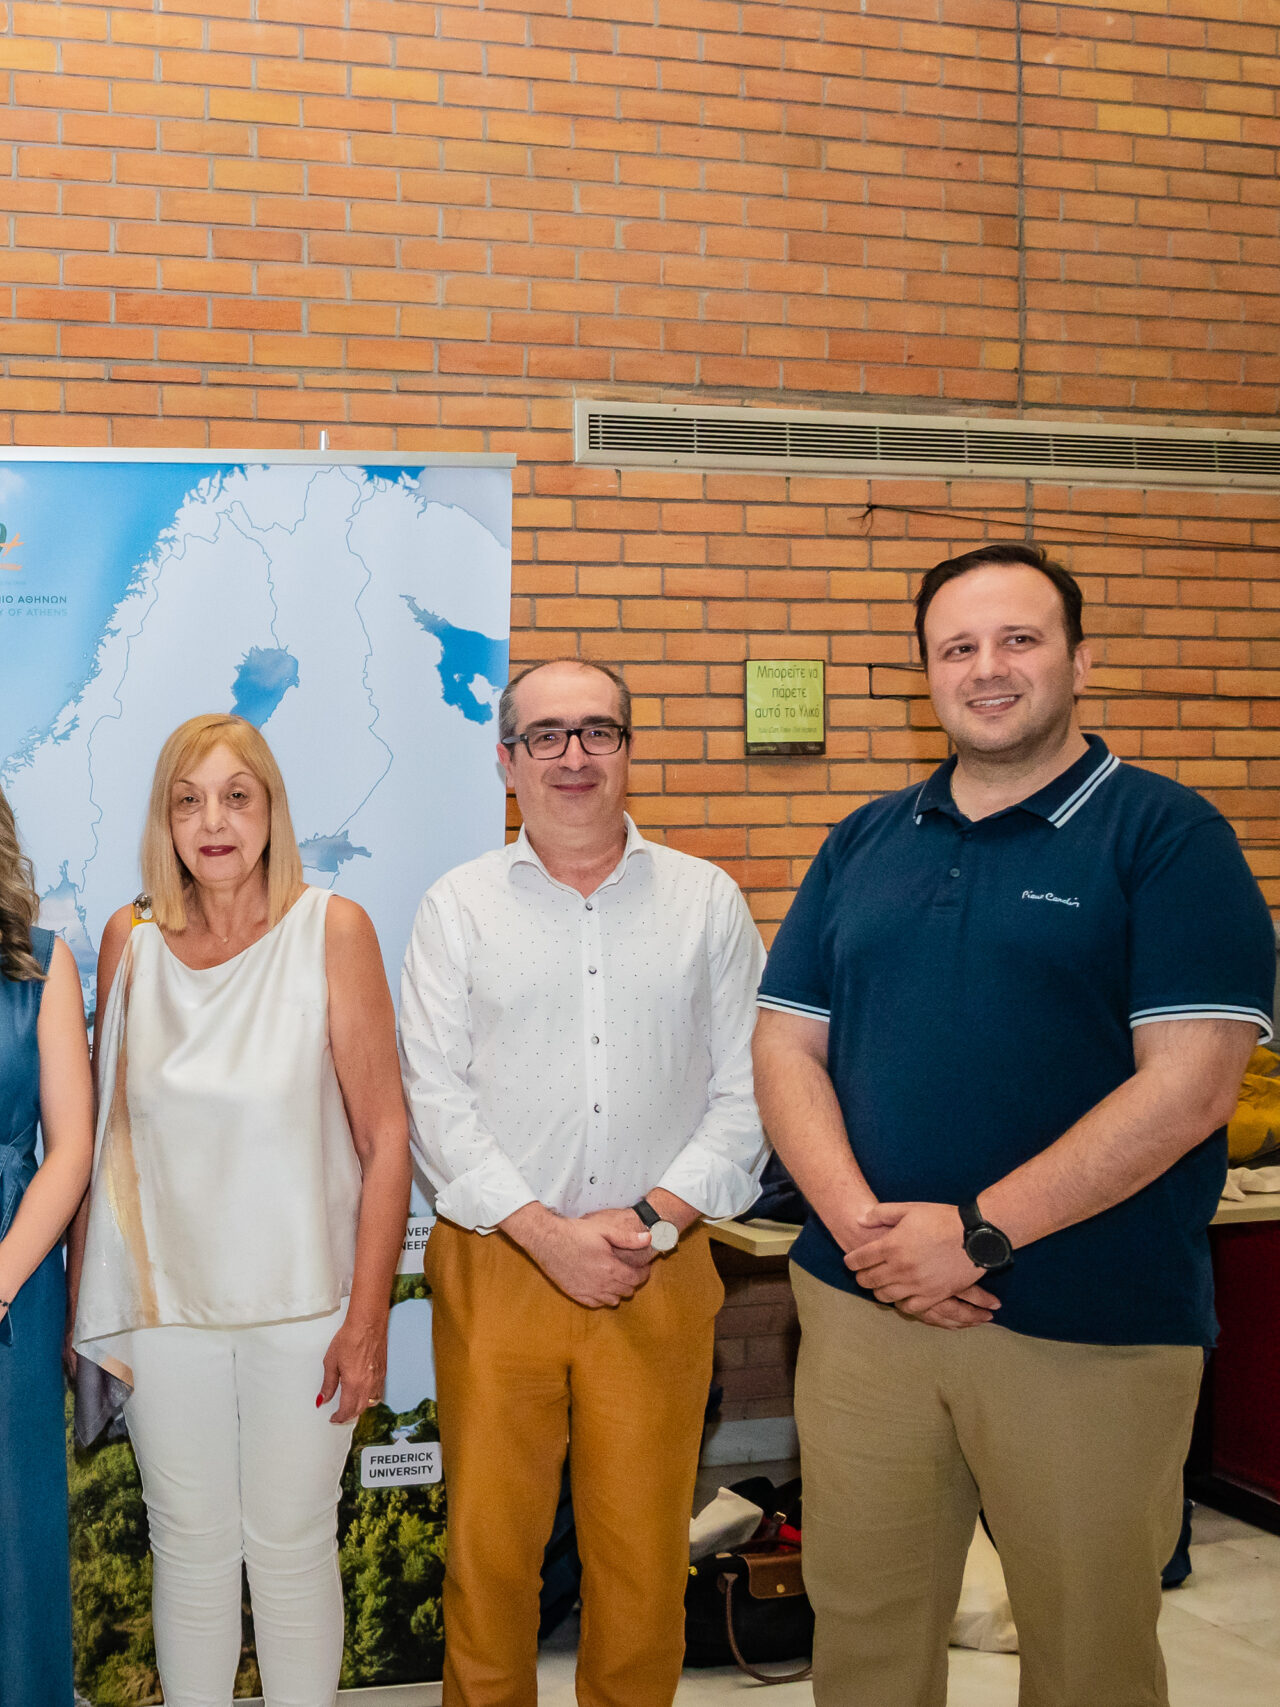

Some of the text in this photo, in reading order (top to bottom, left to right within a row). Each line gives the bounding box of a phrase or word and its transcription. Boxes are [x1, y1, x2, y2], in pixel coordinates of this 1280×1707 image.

[18, 595, 67, 604] ΑΘΗΝΩΝ
[8, 608, 21, 616] OF
[26, 608, 68, 617] ATHENS
[370, 1452, 433, 1466] FREDERICK
[369, 1465, 434, 1479] UNIVERSITY
